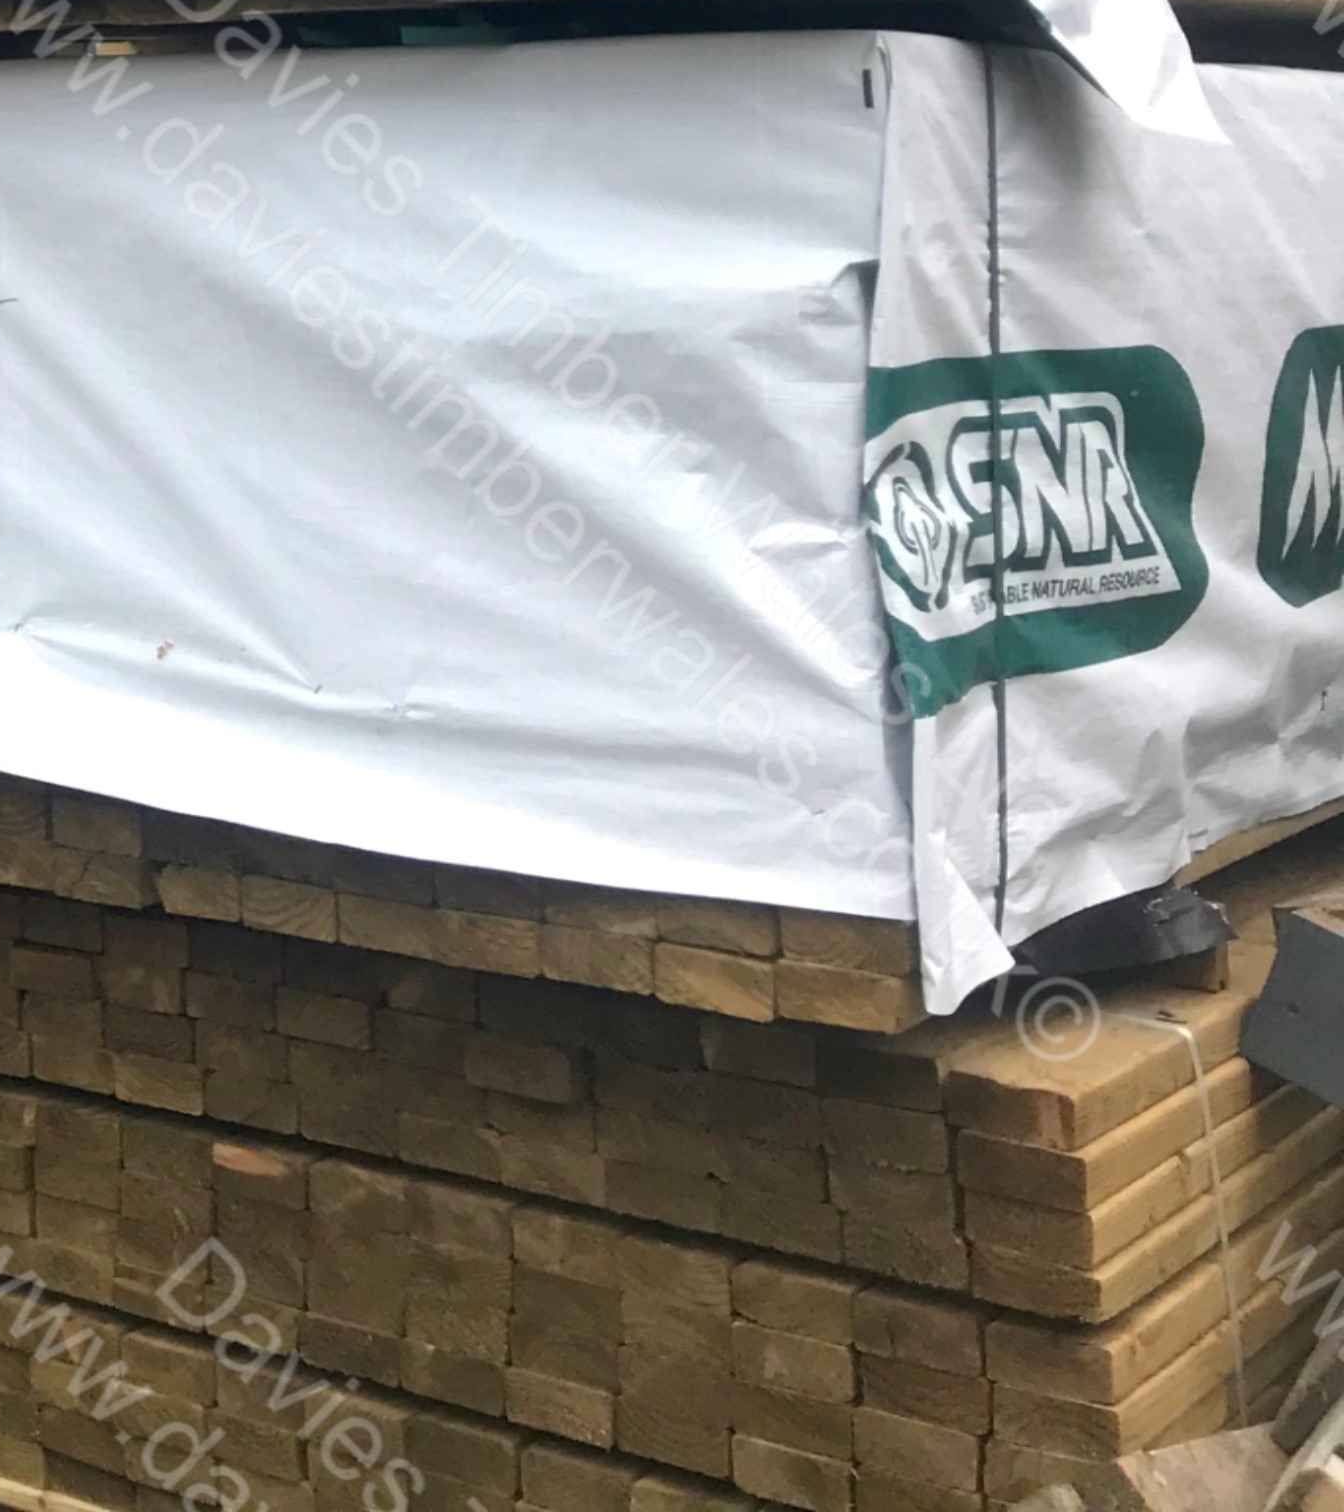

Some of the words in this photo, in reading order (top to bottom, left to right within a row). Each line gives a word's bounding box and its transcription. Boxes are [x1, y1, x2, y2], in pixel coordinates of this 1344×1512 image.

[949, 409, 1159, 578] SNR
[1032, 577, 1095, 601] NATURAL
[1098, 566, 1161, 593] RESOURCE
